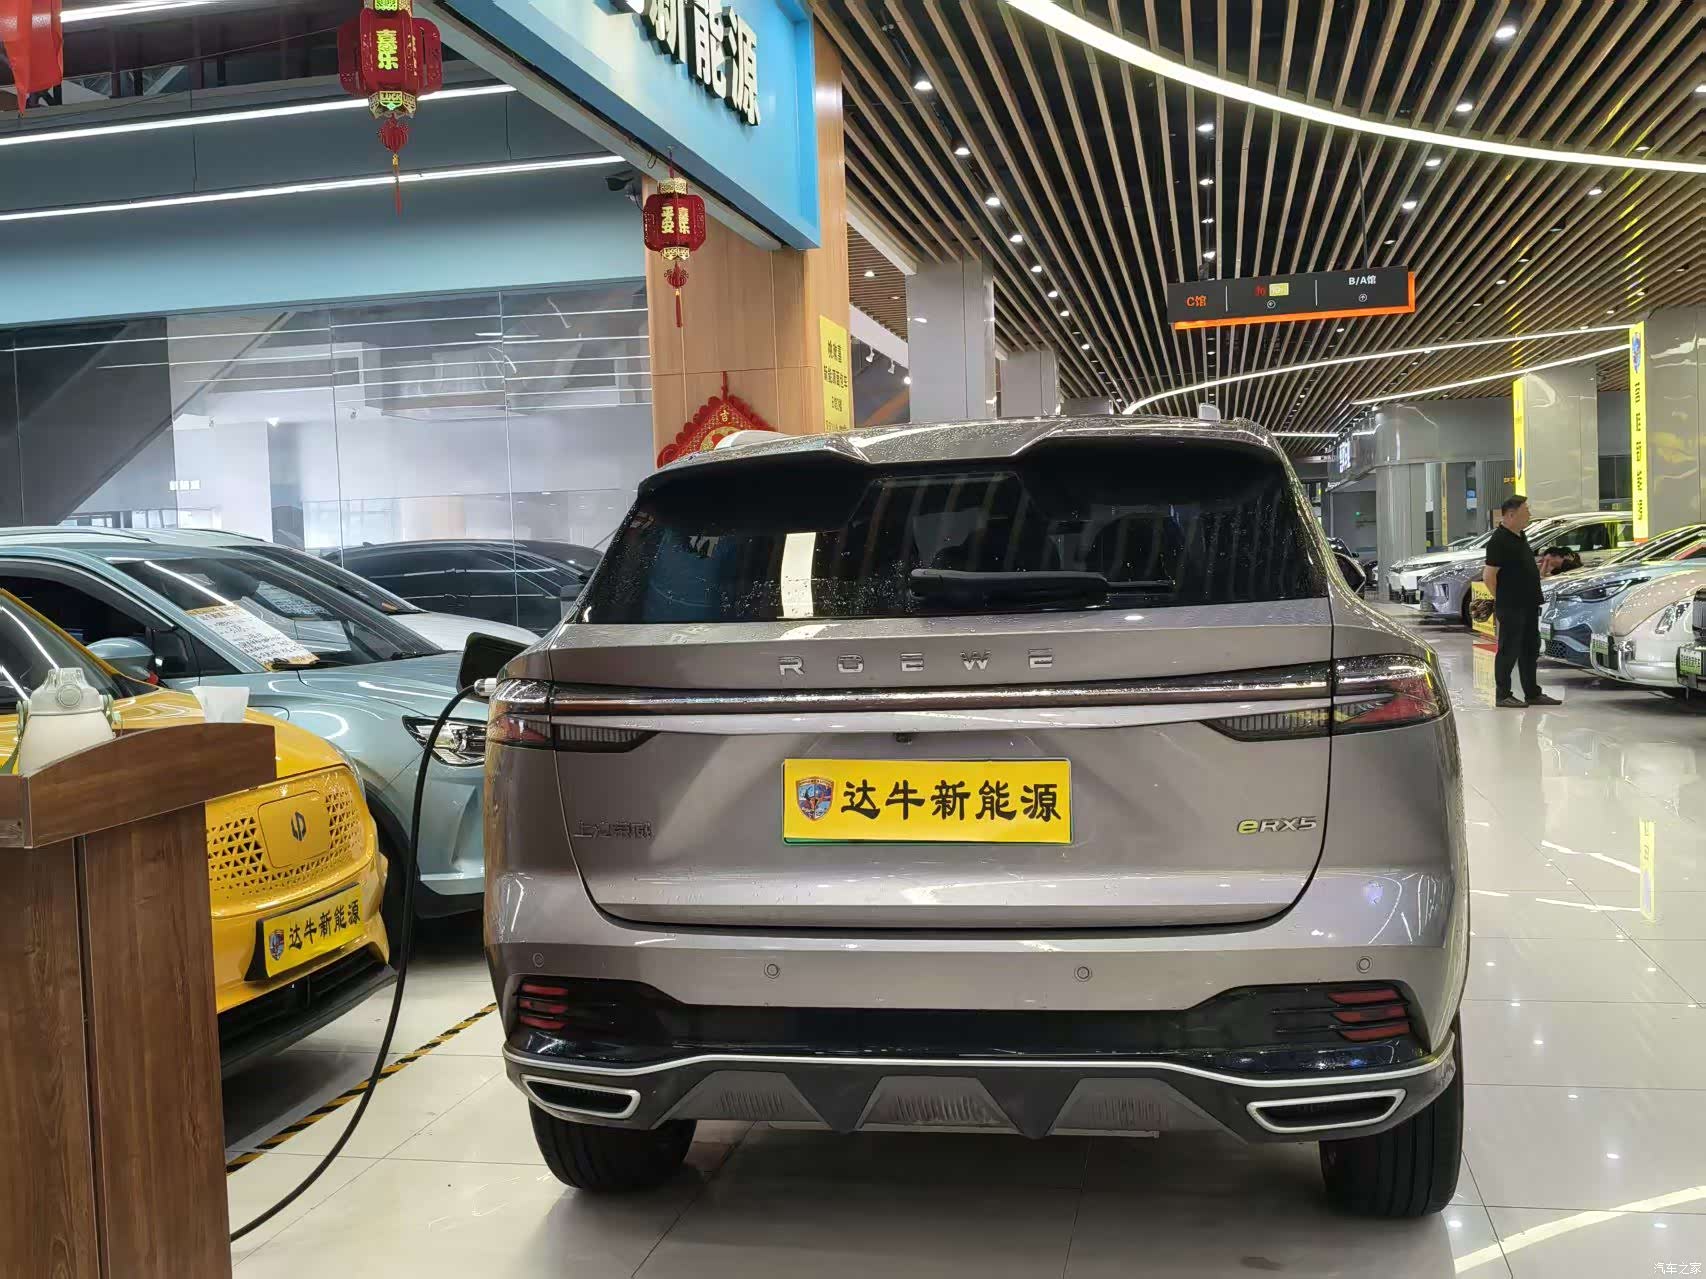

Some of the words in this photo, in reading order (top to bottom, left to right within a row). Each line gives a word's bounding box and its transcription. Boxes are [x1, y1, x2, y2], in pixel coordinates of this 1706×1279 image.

[626, 0, 761, 125] 新能源
[661, 204, 675, 234] 平安
[1348, 274, 1377, 286] B/A馆
[1186, 295, 1208, 308] C馆
[778, 647, 1053, 676] ROEWE
[840, 778, 1062, 823] 达牛新能源
[1237, 815, 1318, 835] eRX5
[288, 899, 361, 951] 达牛新能源
